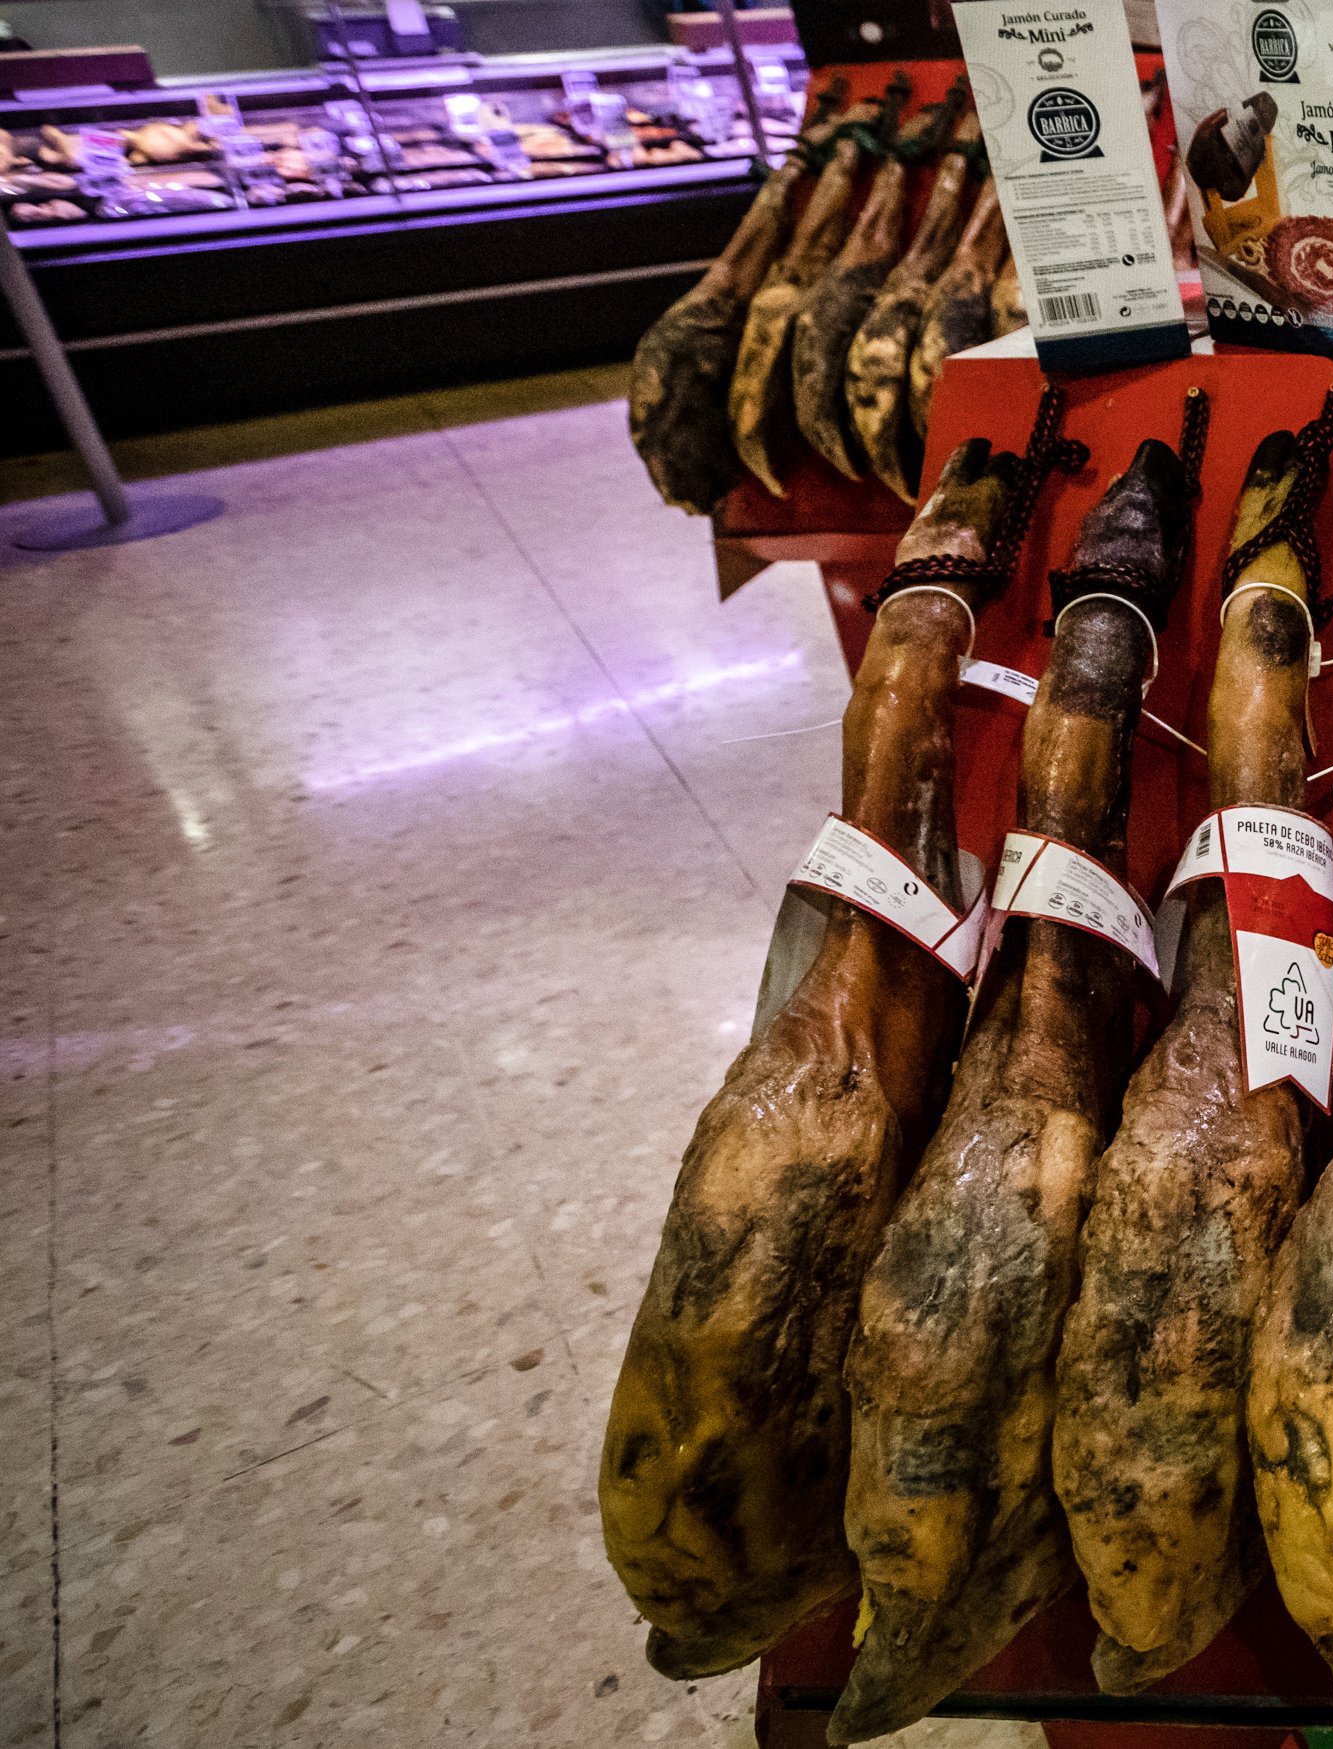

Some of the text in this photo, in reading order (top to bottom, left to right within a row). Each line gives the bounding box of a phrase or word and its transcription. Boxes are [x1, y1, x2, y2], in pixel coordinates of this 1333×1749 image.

[1001, 10, 1086, 26] Jamón Curado
[1029, 28, 1066, 44] Mini
[1259, 38, 1290, 56] BARRICA
[1040, 115, 1089, 134] BARRICA
[1237, 821, 1314, 848] PALETA DE CEBO
[1263, 838, 1326, 868] 50% RAZA IBÉRICA
[1295, 996, 1314, 1025] VA
[1265, 1040, 1317, 1064] VALLE ALAGON
